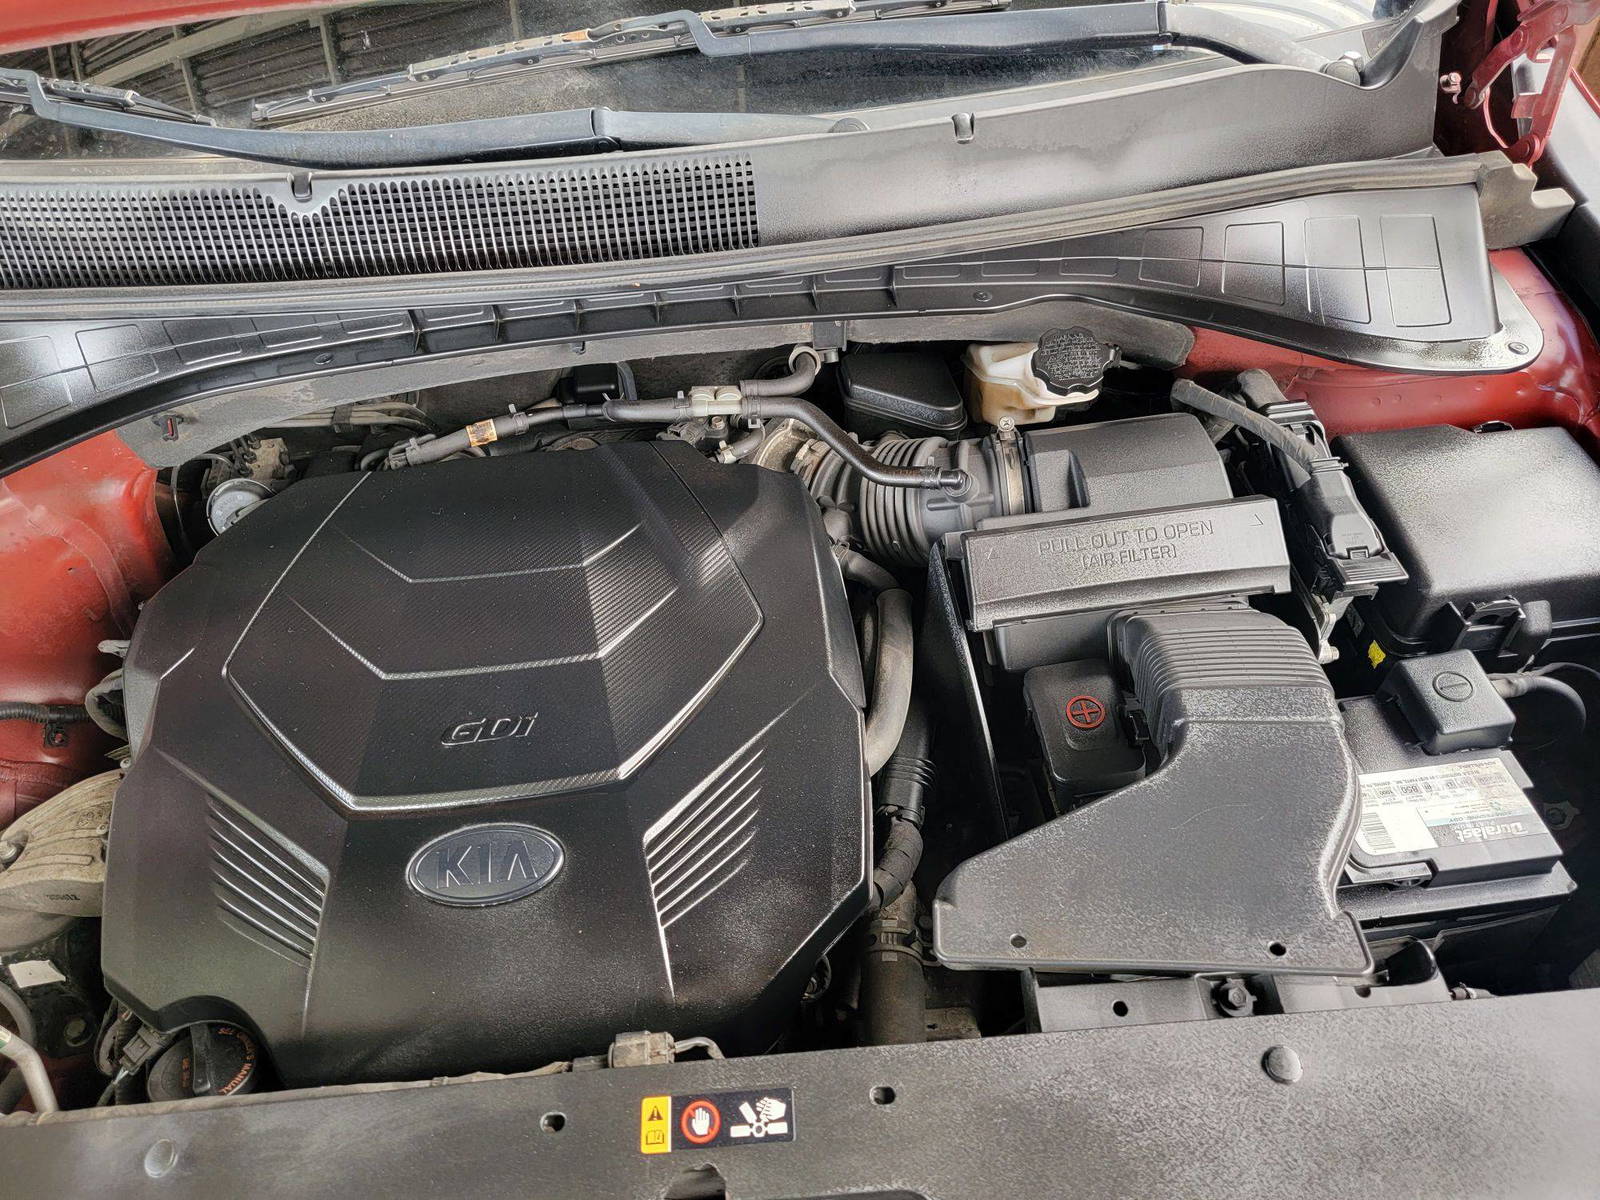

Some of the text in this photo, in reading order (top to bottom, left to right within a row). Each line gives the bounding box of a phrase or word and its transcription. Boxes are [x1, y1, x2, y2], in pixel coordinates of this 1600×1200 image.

[1039, 520, 1214, 555] PULL OUT TO OPEN
[1082, 543, 1178, 569] (AIR FILTER)
[1455, 821, 1528, 843] Duralast
[436, 840, 539, 889] KIA
